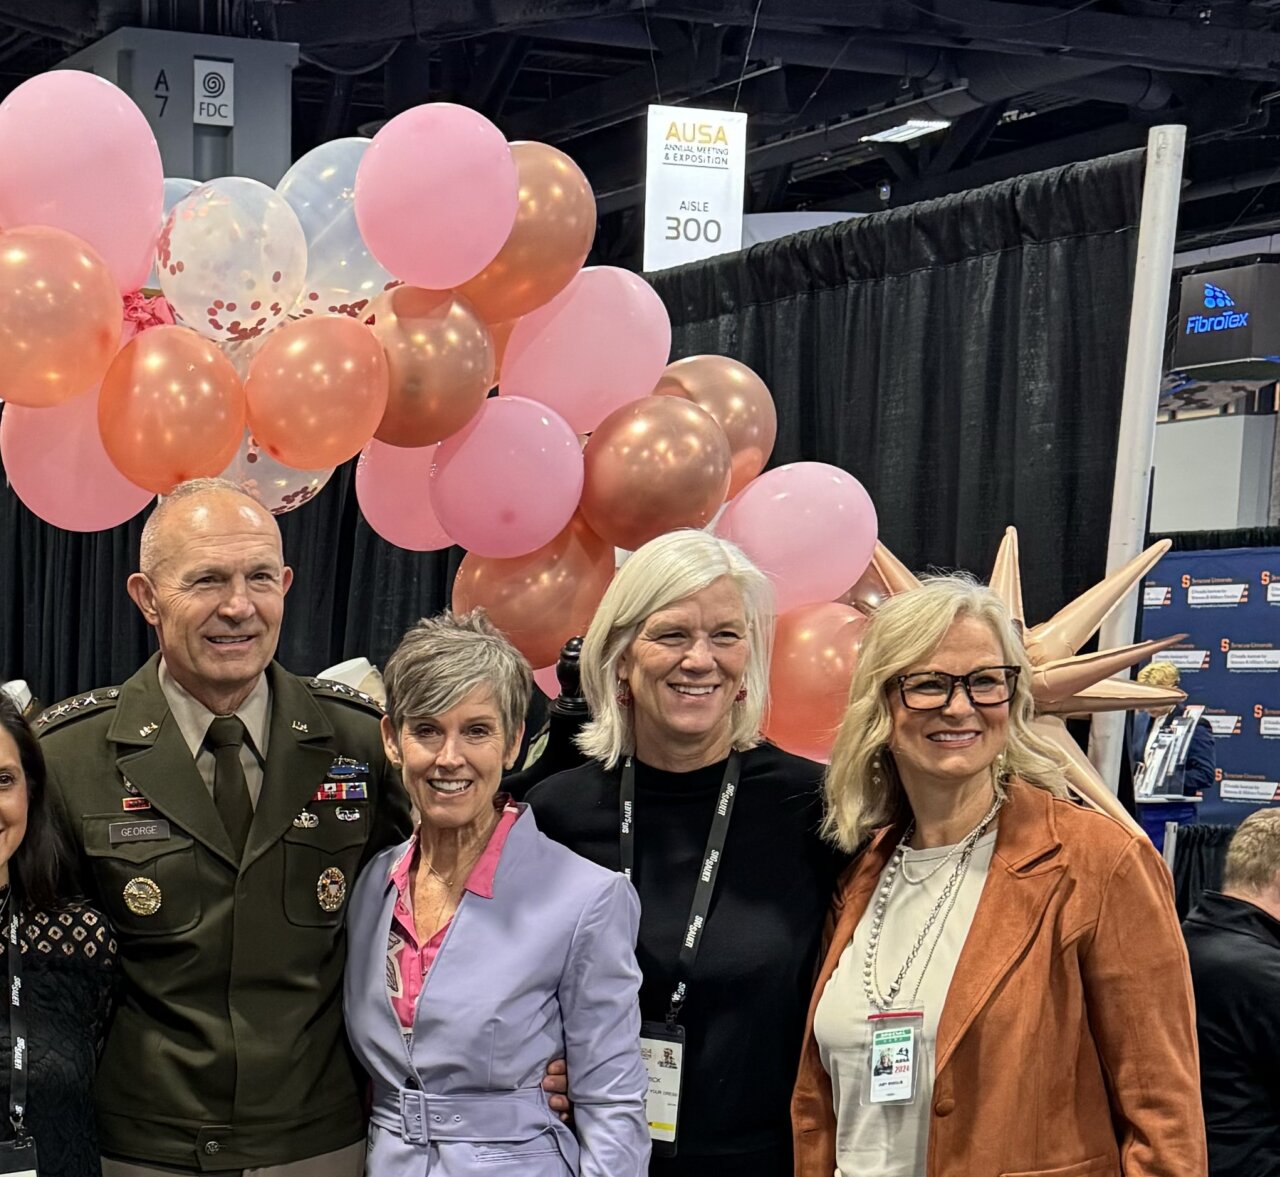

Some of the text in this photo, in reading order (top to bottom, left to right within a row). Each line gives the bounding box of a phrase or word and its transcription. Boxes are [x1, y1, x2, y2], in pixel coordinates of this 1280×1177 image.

[154, 69, 169, 92] A
[155, 94, 169, 118] 7
[199, 101, 229, 118] FDC
[665, 121, 728, 145] AUSA
[664, 144, 729, 155] ANNUAL MEETING
[664, 153, 728, 165] & EXPOSITION
[679, 200, 710, 212] AISLE
[665, 216, 722, 242] 300
[121, 825, 158, 837] GEORGE
